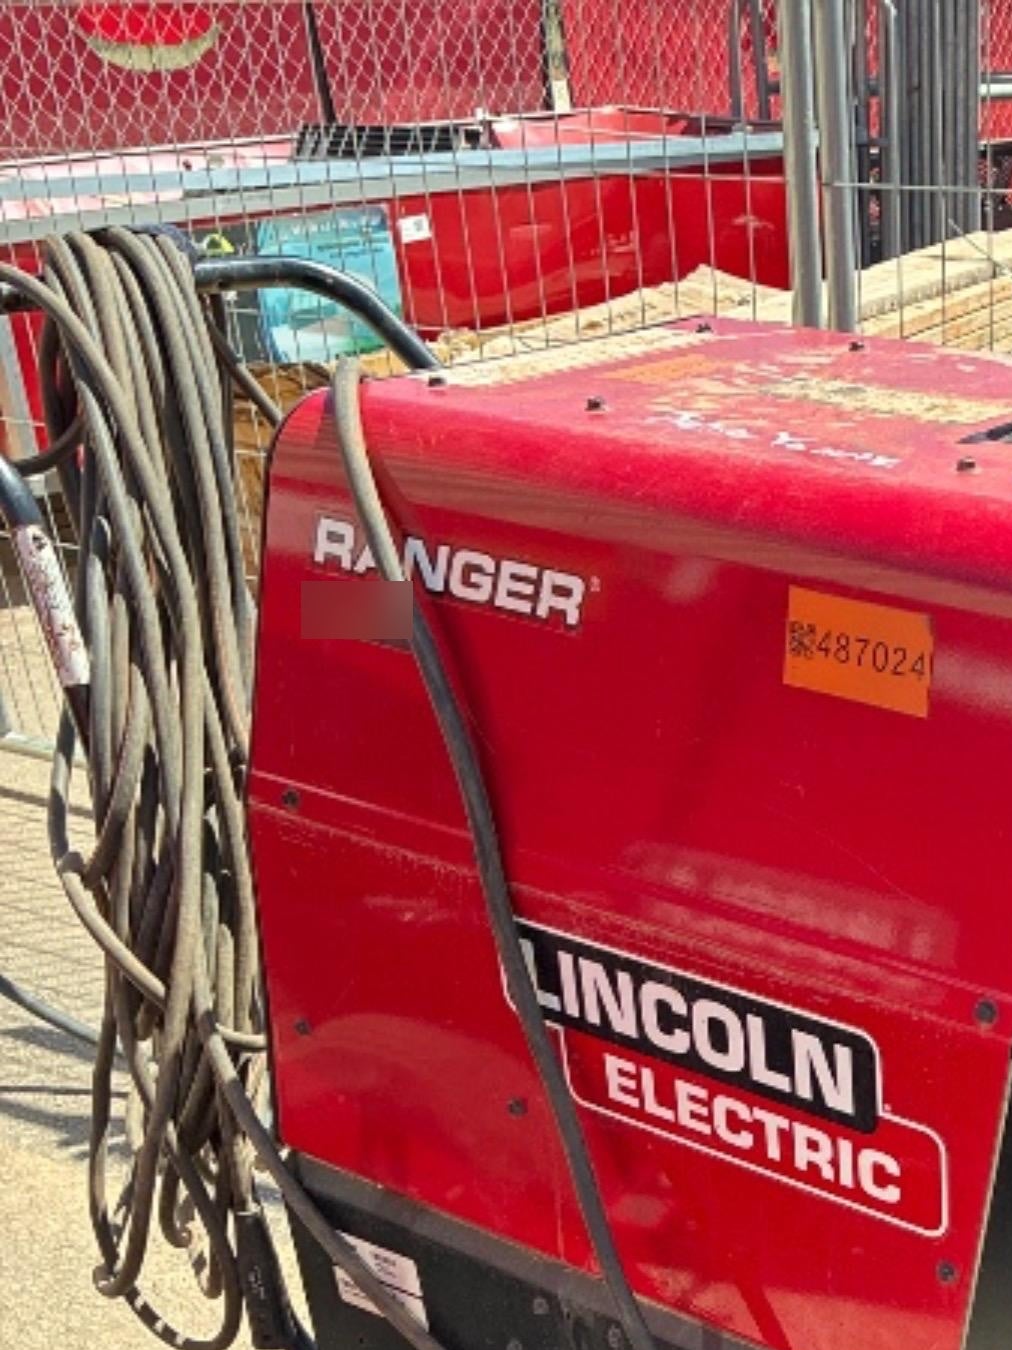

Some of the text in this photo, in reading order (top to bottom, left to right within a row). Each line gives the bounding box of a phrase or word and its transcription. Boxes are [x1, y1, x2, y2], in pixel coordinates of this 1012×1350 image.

[816, 630, 925, 681] 487024
[518, 938, 856, 1116] LINCOLN
[604, 1052, 901, 1203] ELECTRIC
